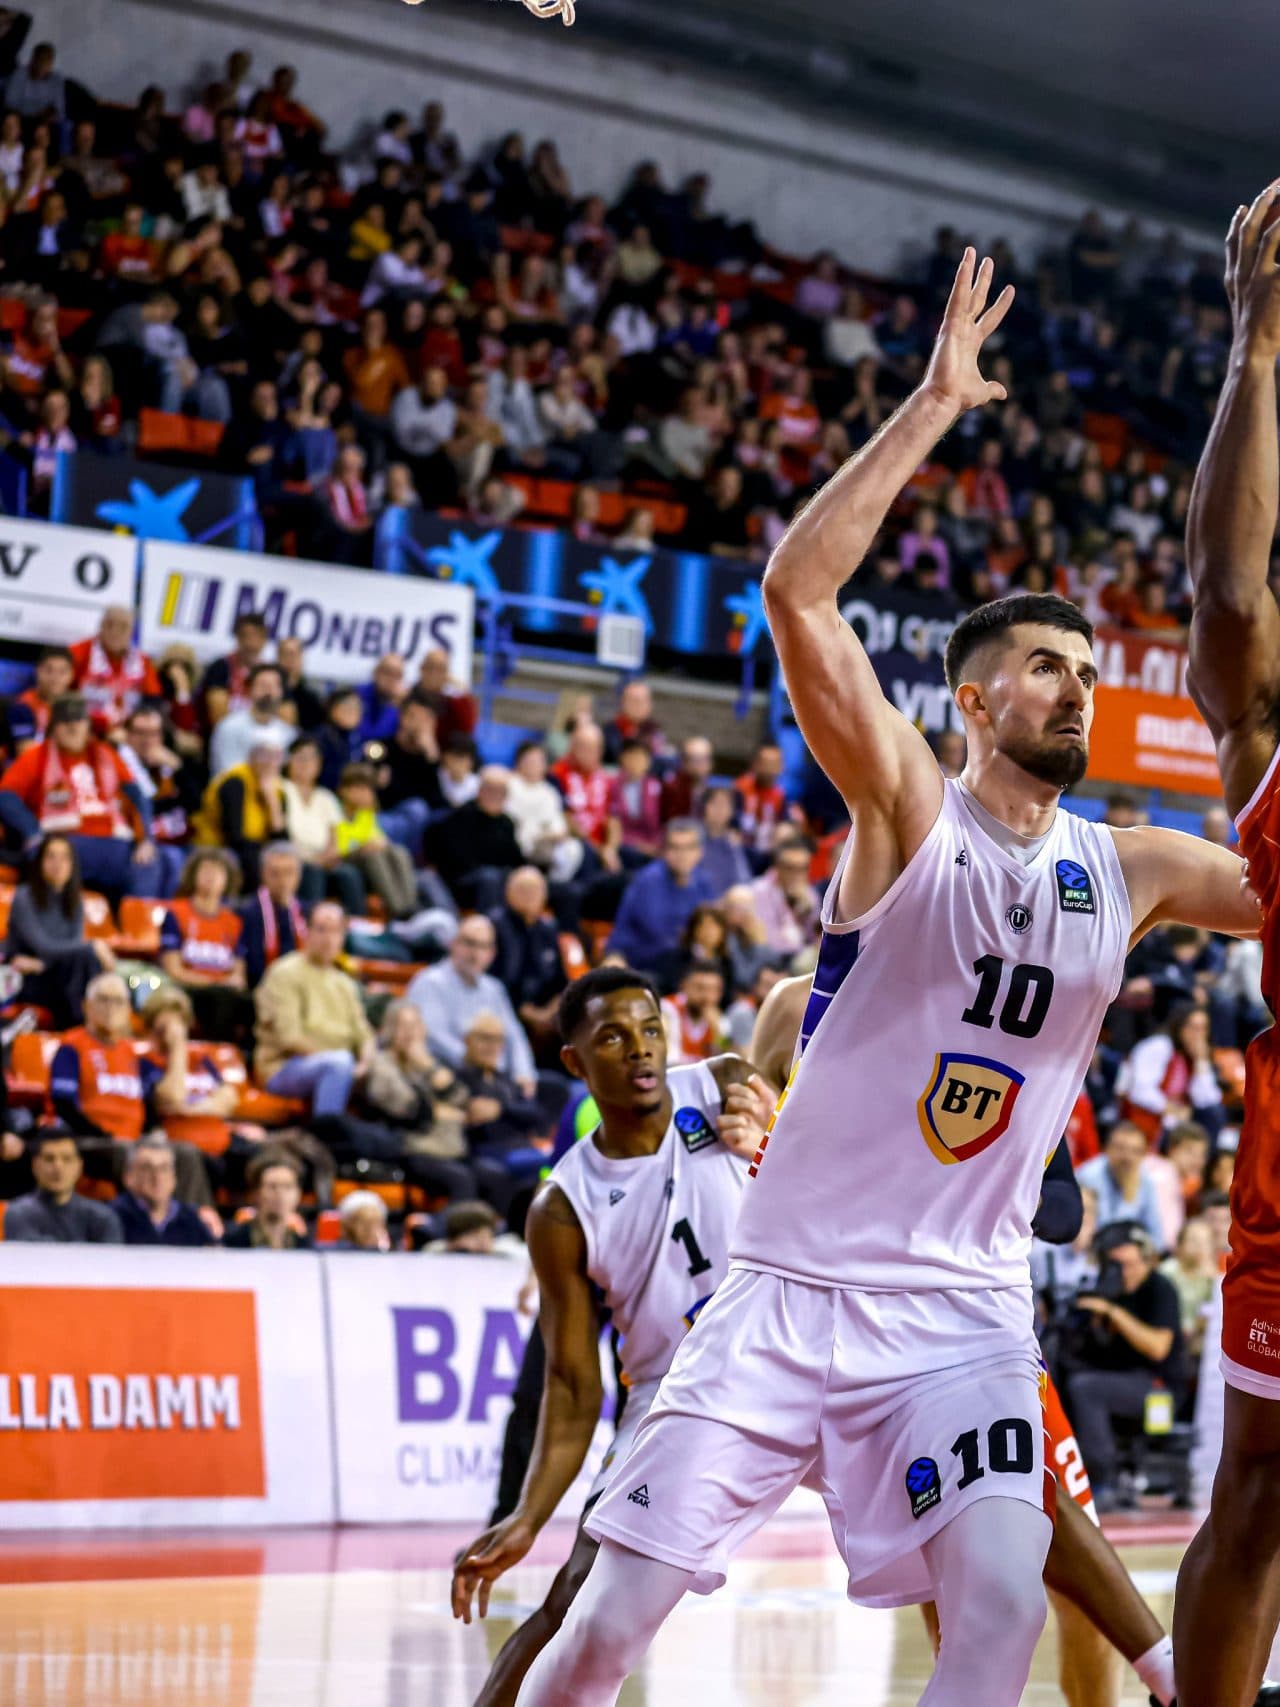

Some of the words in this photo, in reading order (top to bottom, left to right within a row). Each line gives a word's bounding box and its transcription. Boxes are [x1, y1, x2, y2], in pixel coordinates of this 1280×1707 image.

[1063, 899, 1093, 910] EuroCup
[961, 953, 1055, 1039] 10
[941, 1077, 1002, 1121] BT
[671, 1217, 713, 1278] 1
[1249, 1328, 1268, 1345] ETL
[89, 1374, 240, 1429] DAMM
[950, 1418, 1033, 1490] 10
[1055, 1436, 1090, 1498] 2
[627, 1492, 651, 1509] PEAK
